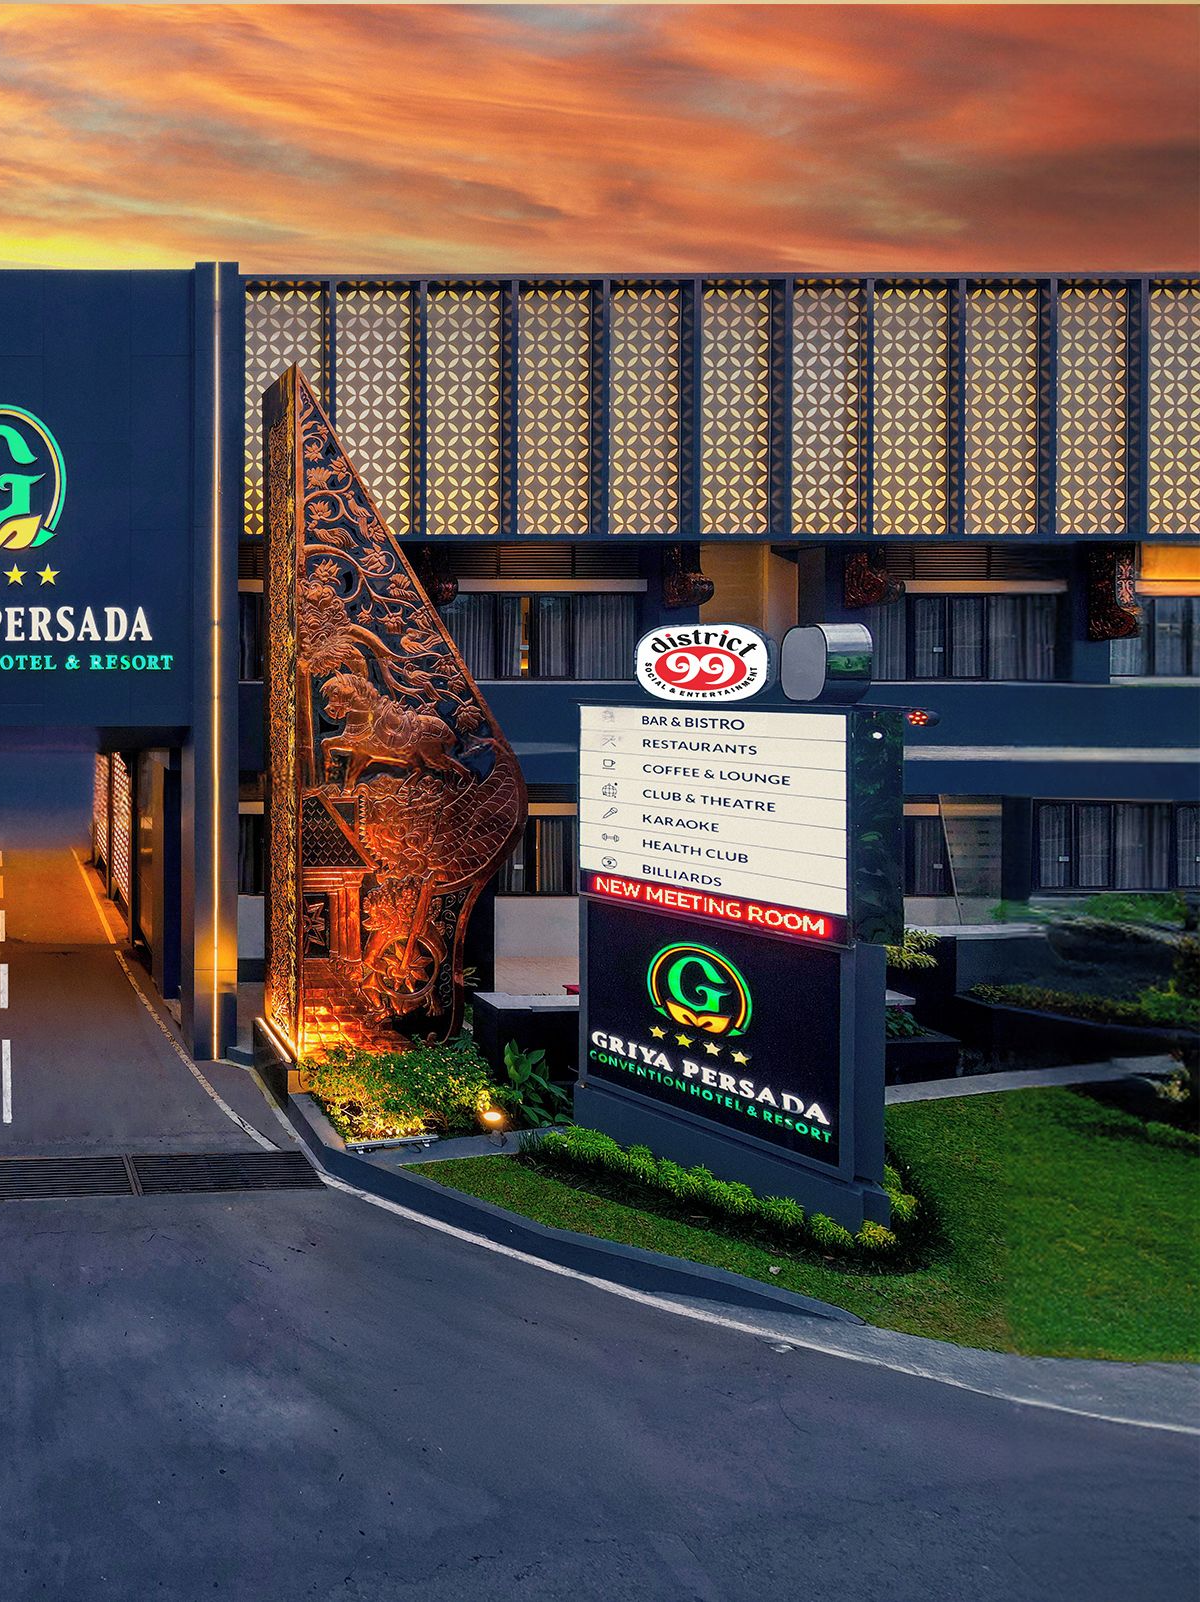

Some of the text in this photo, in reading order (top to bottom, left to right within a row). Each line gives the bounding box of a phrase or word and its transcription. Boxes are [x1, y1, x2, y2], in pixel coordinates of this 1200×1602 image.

[651, 629, 757, 657] district
[64, 654, 81, 670] &
[89, 654, 174, 671] RESORT
[665, 652, 736, 685] 99
[645, 662, 666, 690] SOCIAL
[679, 667, 758, 698] ENTERTAINMENT
[641, 714, 745, 731] BAR & BISTRO
[642, 738, 758, 756] RESTAURANTS
[642, 763, 791, 787] COFFEE & LOUNGE
[642, 788, 776, 813] CLUB & THEATRE
[642, 813, 720, 833] KARAOKE
[642, 838, 749, 864] HEALTH CLUB
[642, 863, 722, 887] BILLIARDS
[596, 876, 825, 935] NEW MEETING ROOM
[591, 1031, 831, 1125] GRIYA PERSADA
[589, 1050, 832, 1144] CONVENTION HOTEL & RESORT
